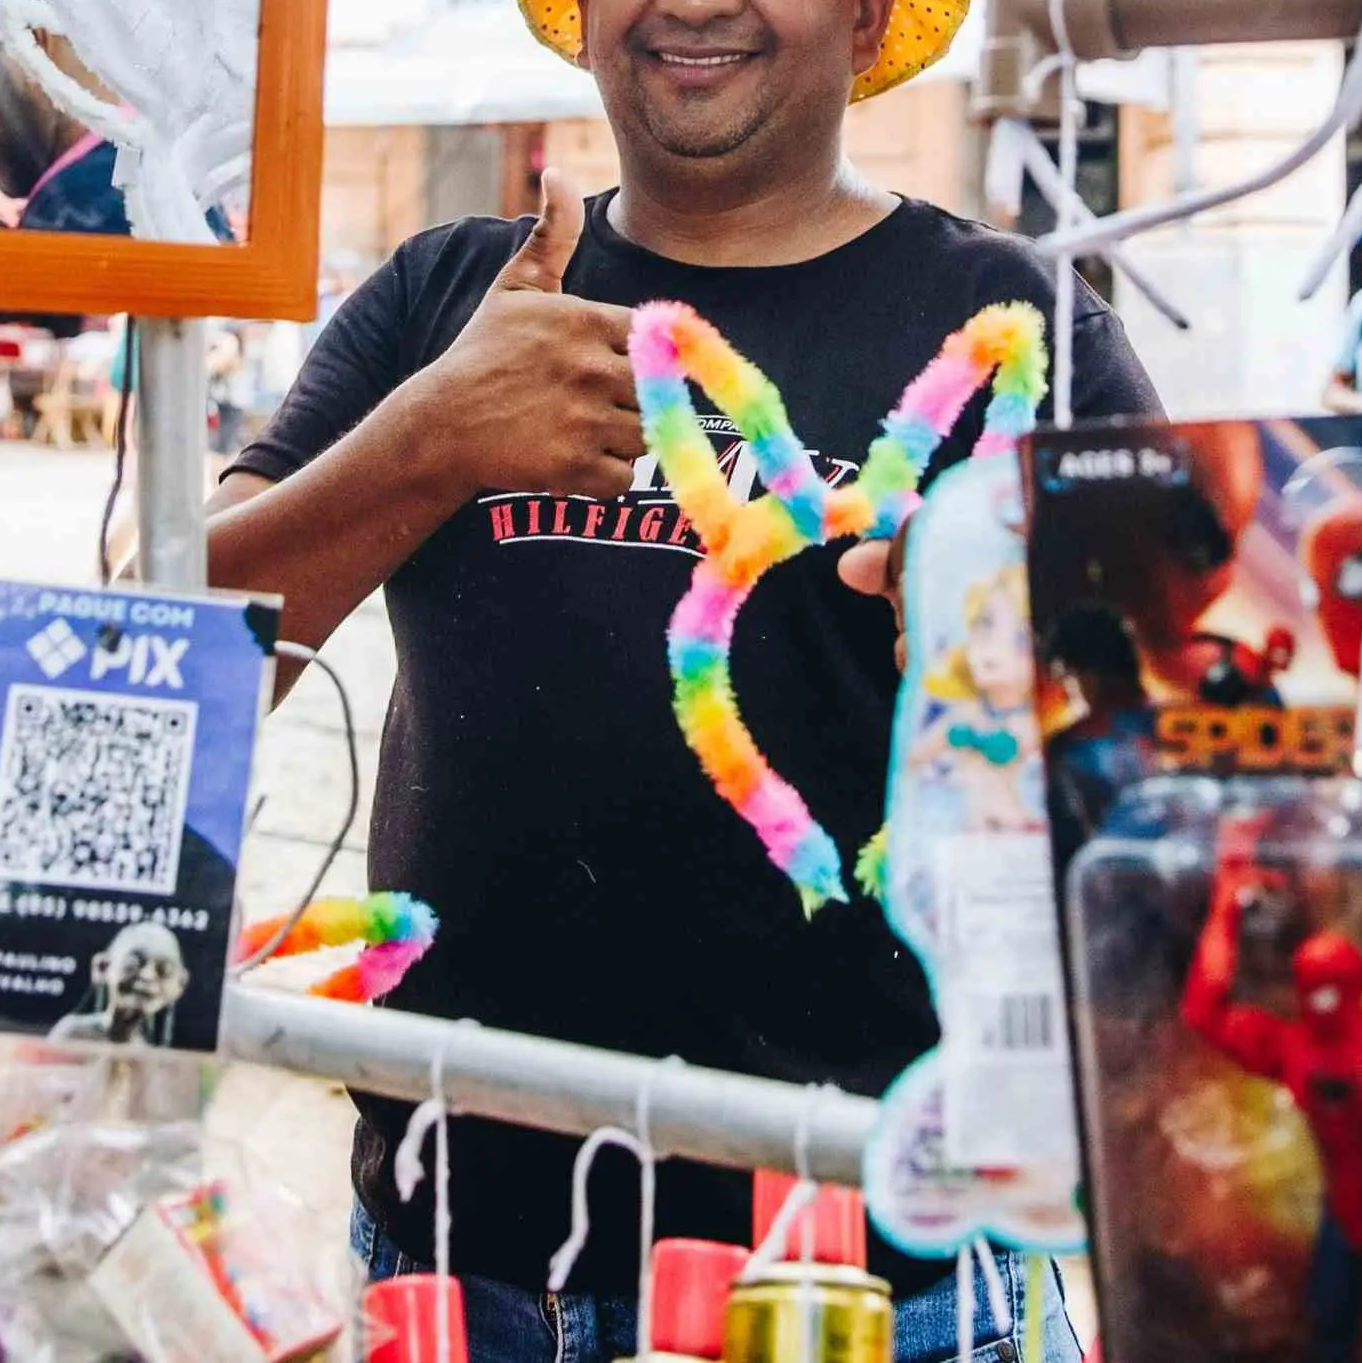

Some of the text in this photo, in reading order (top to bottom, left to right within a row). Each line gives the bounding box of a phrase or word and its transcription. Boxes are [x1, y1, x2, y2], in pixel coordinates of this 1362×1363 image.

[697, 419, 740, 431] OMPA
[489, 500, 705, 552] HILFIGE
[39, 591, 195, 628] PAGUE COM
[89, 632, 190, 689] PIX
